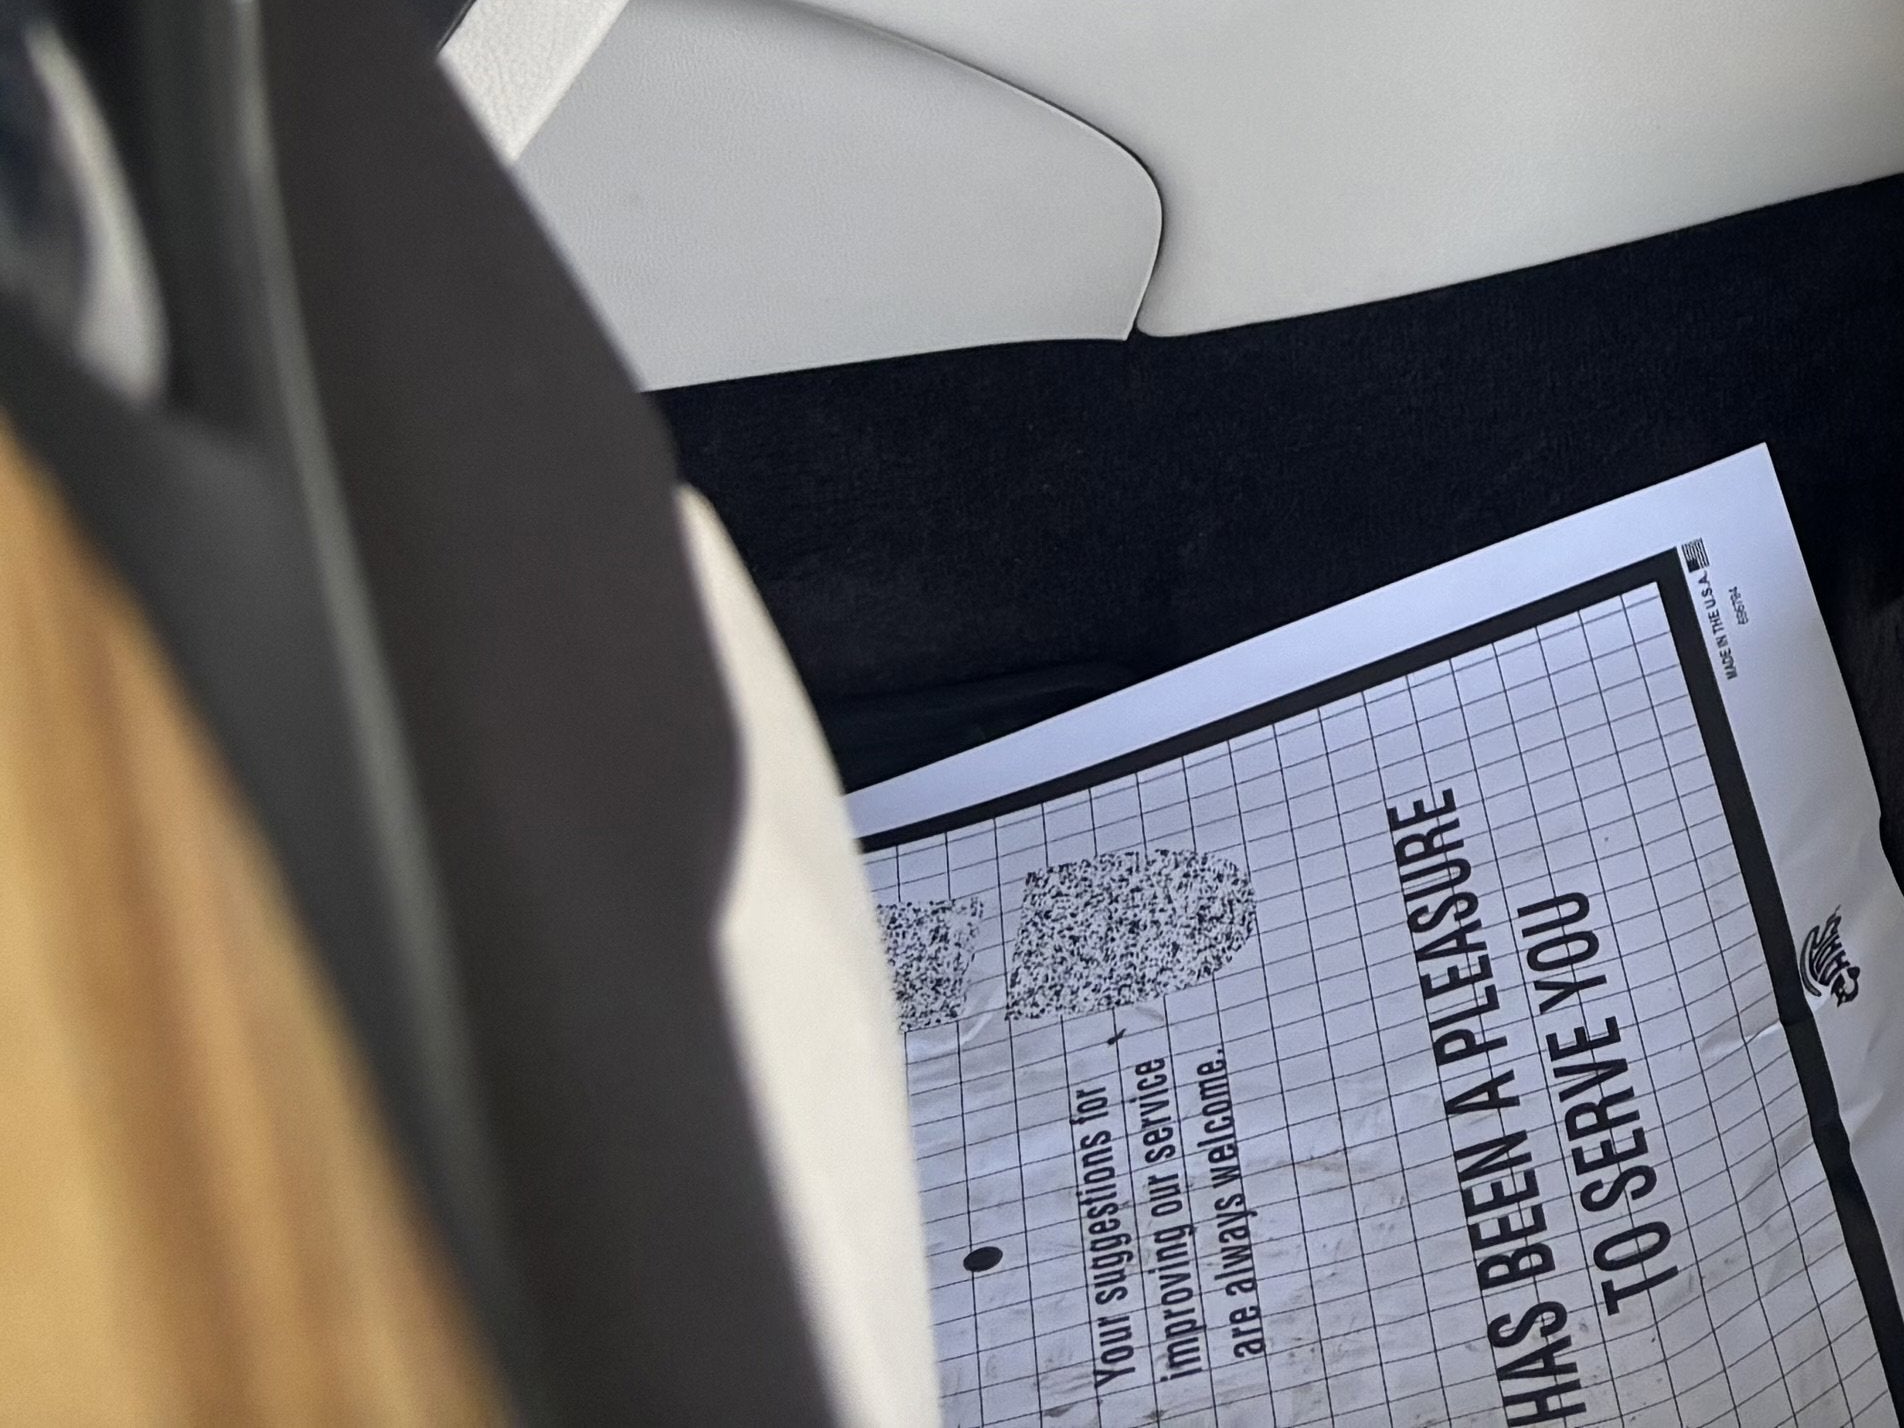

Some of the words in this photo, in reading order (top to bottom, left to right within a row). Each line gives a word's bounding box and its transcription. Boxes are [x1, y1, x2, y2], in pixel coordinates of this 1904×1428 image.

[1708, 608, 1725, 634] THE
[1716, 634, 1728, 647] IN
[1719, 647, 1738, 680] MADE
[1387, 788, 1508, 1067] PLEASURE
[1517, 891, 1607, 1014] YOU
[1069, 1086, 1109, 1123] for
[1128, 1057, 1176, 1160] service
[1193, 1047, 1243, 1189] welcome.
[1444, 1070, 1520, 1116] A
[1545, 1015, 1657, 1213] SERVE
[1076, 1128, 1134, 1305] suggestions
[1147, 1172, 1182, 1216] our
[1206, 1193, 1257, 1295] always
[1453, 1129, 1556, 1291] BEEN
[1147, 1224, 1206, 1382] improving
[1593, 1219, 1679, 1315] TO
[1093, 1314, 1136, 1388] Your
[1229, 1304, 1266, 1358] are
[1487, 1300, 1586, 1427] HAS
